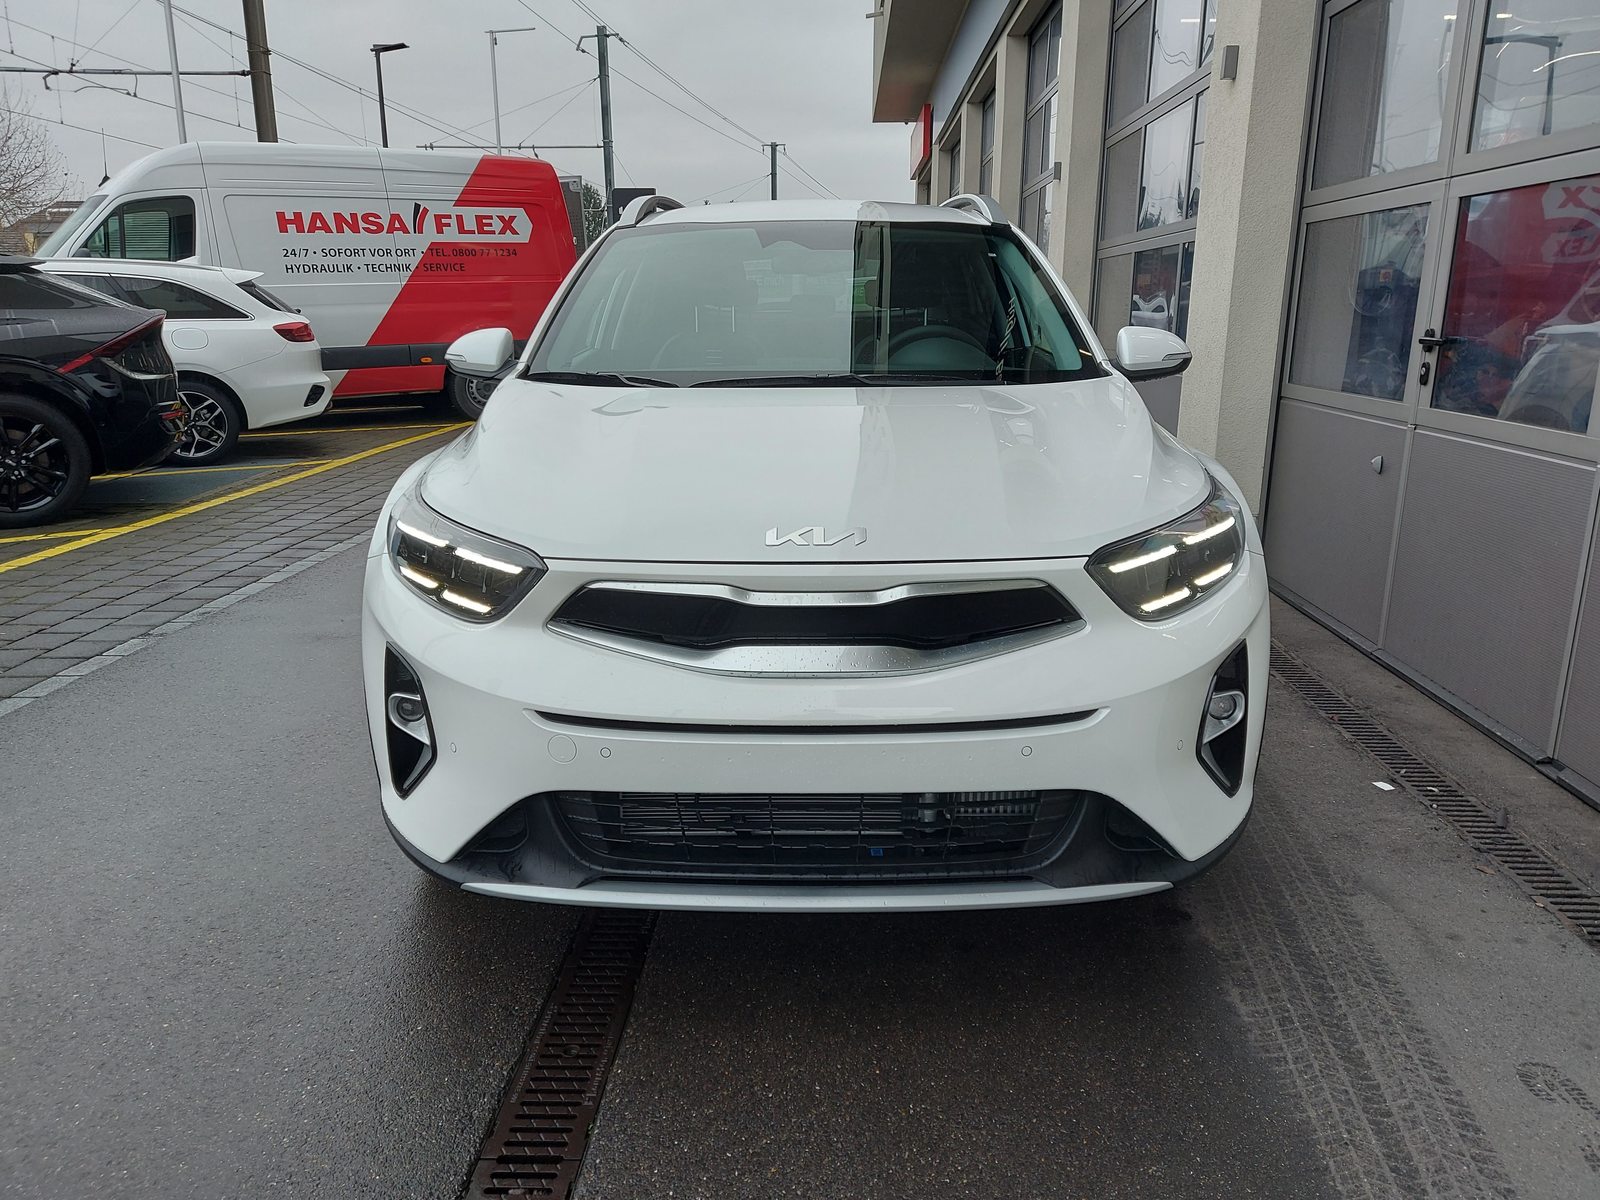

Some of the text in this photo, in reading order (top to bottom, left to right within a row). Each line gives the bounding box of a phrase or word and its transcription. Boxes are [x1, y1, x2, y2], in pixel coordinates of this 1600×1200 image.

[275, 211, 520, 235] HANSA FLEX
[282, 248, 517, 258] 24/7 SOFORT VOR ORT TEL. 0800 77 1234
[285, 263, 466, 273] HYDRAULIK TECHNIK SERVICE
[765, 526, 867, 546] KIA
